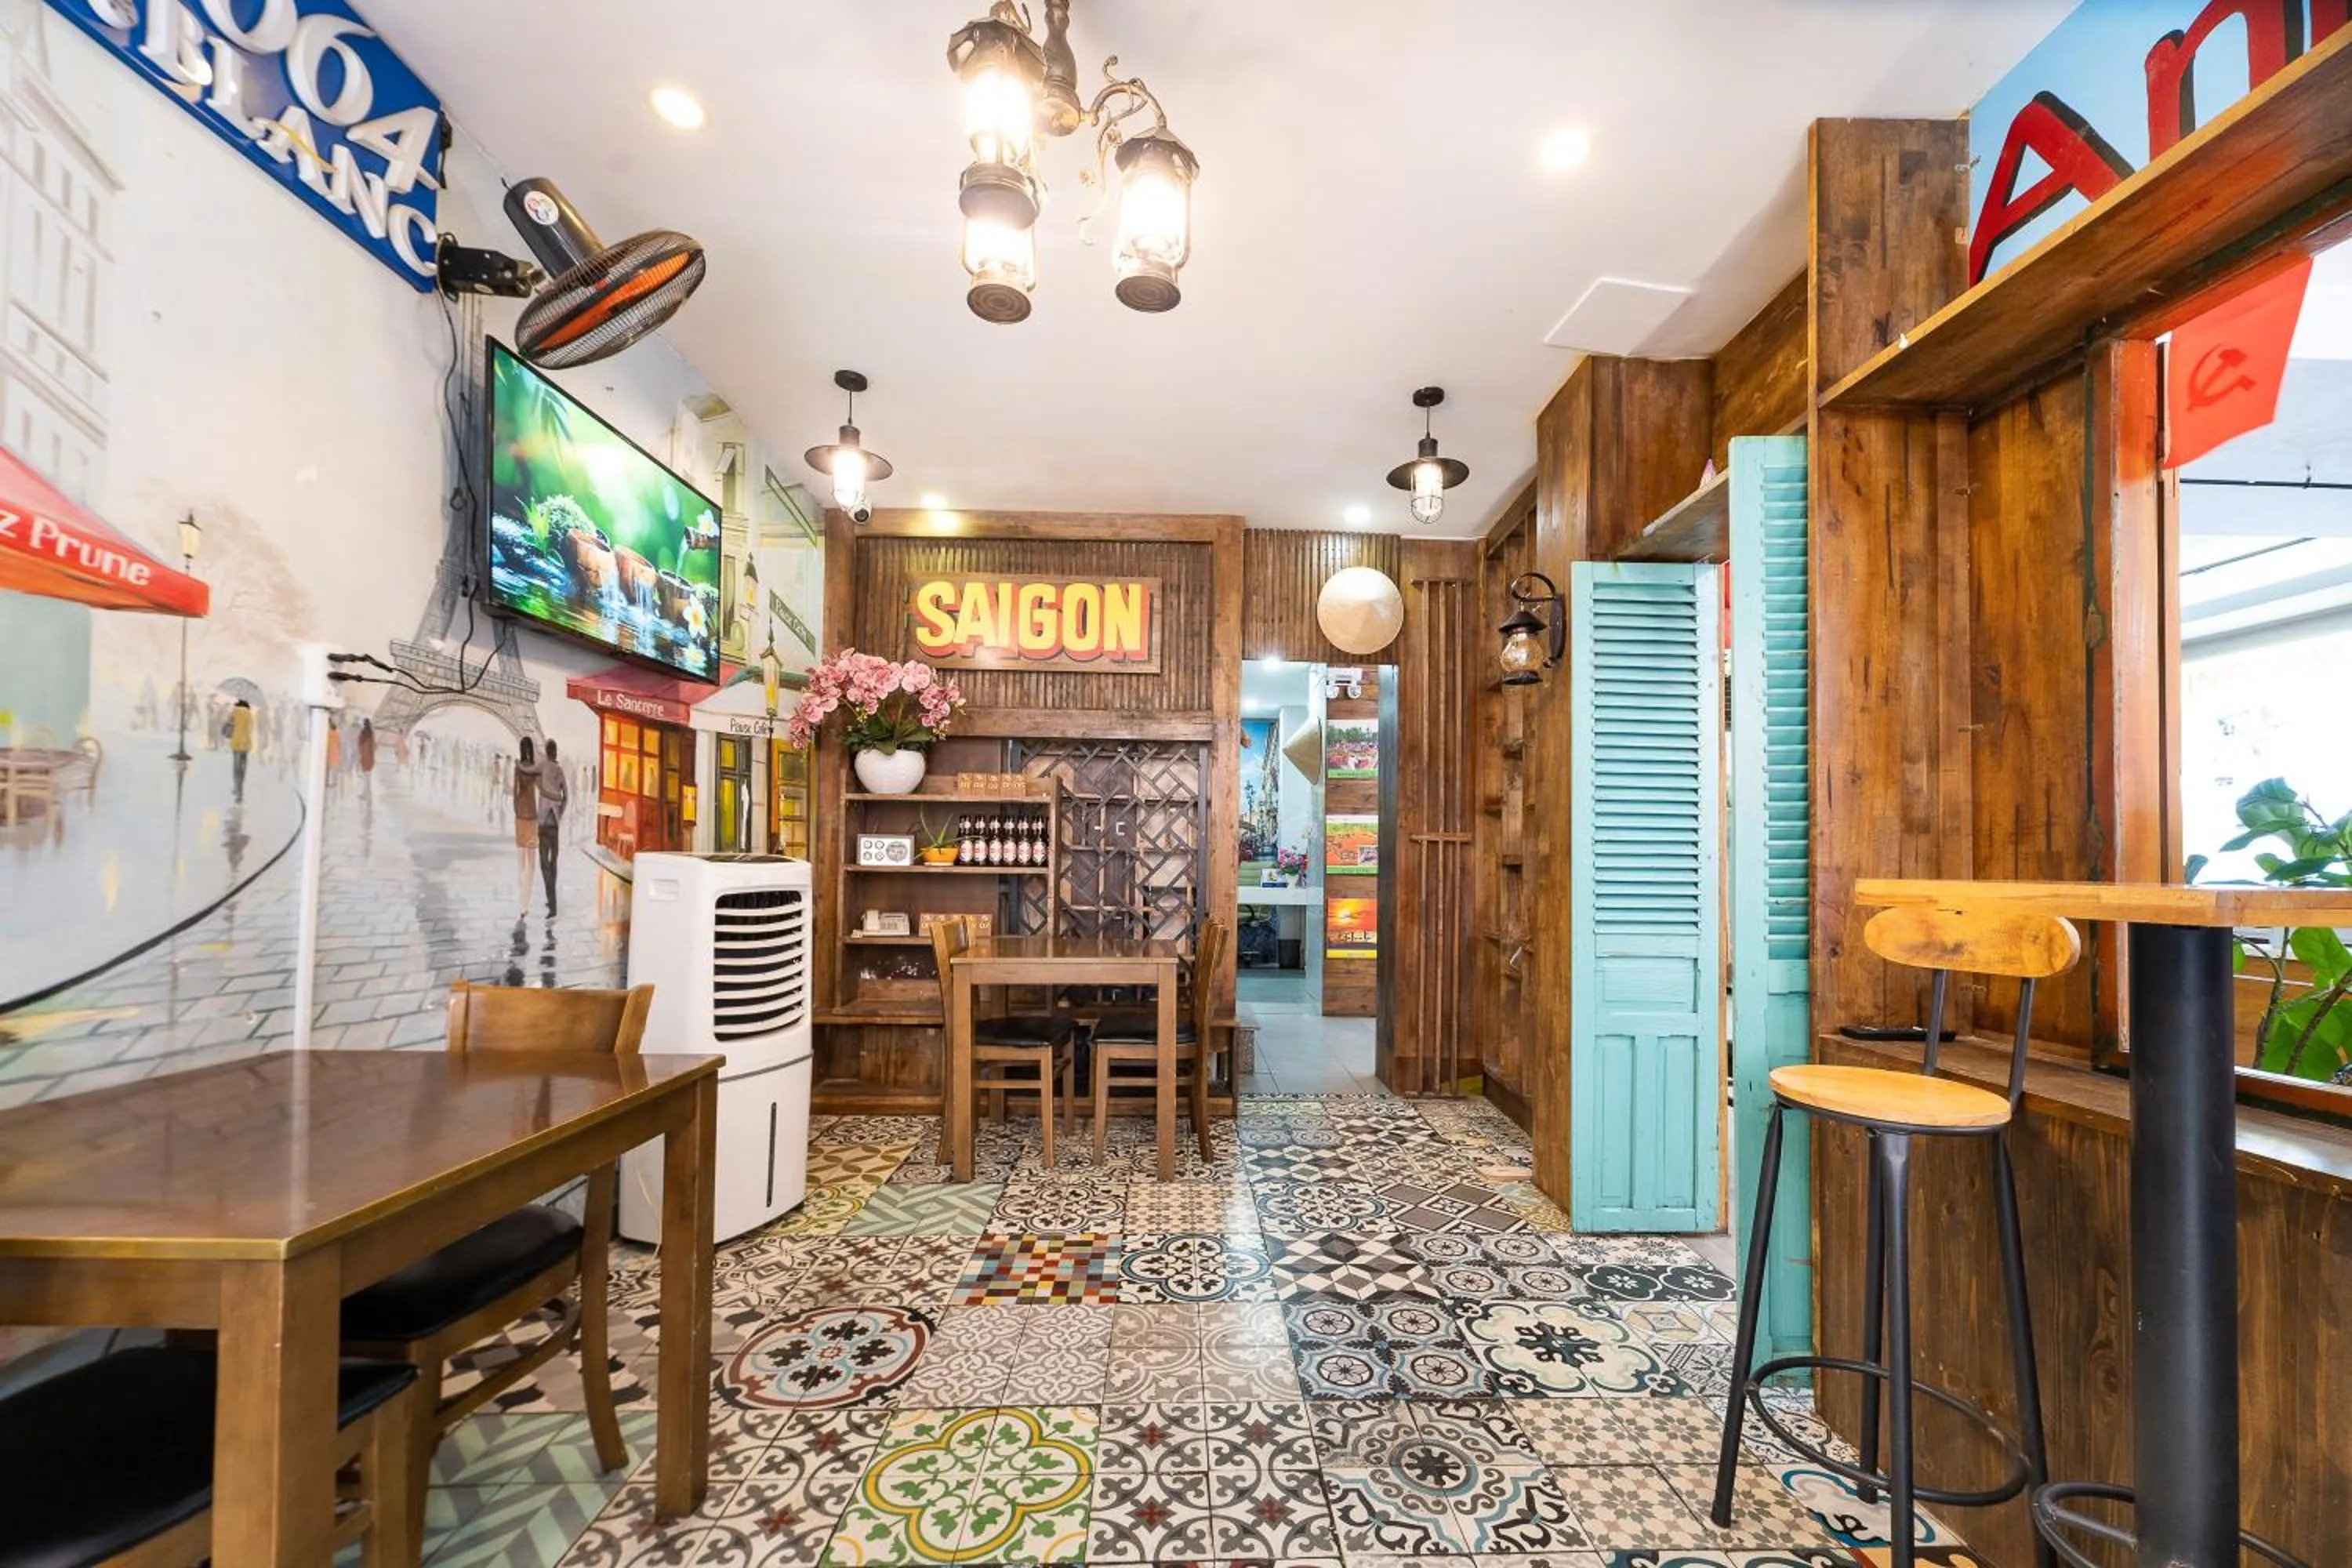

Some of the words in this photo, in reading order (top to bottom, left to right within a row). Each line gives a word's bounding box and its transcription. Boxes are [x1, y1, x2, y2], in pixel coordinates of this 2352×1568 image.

[137, 0, 439, 278] BLANC
[29, 516, 151, 586] Prune
[915, 580, 1150, 662] SAIGON
[597, 690, 612, 706] Le
